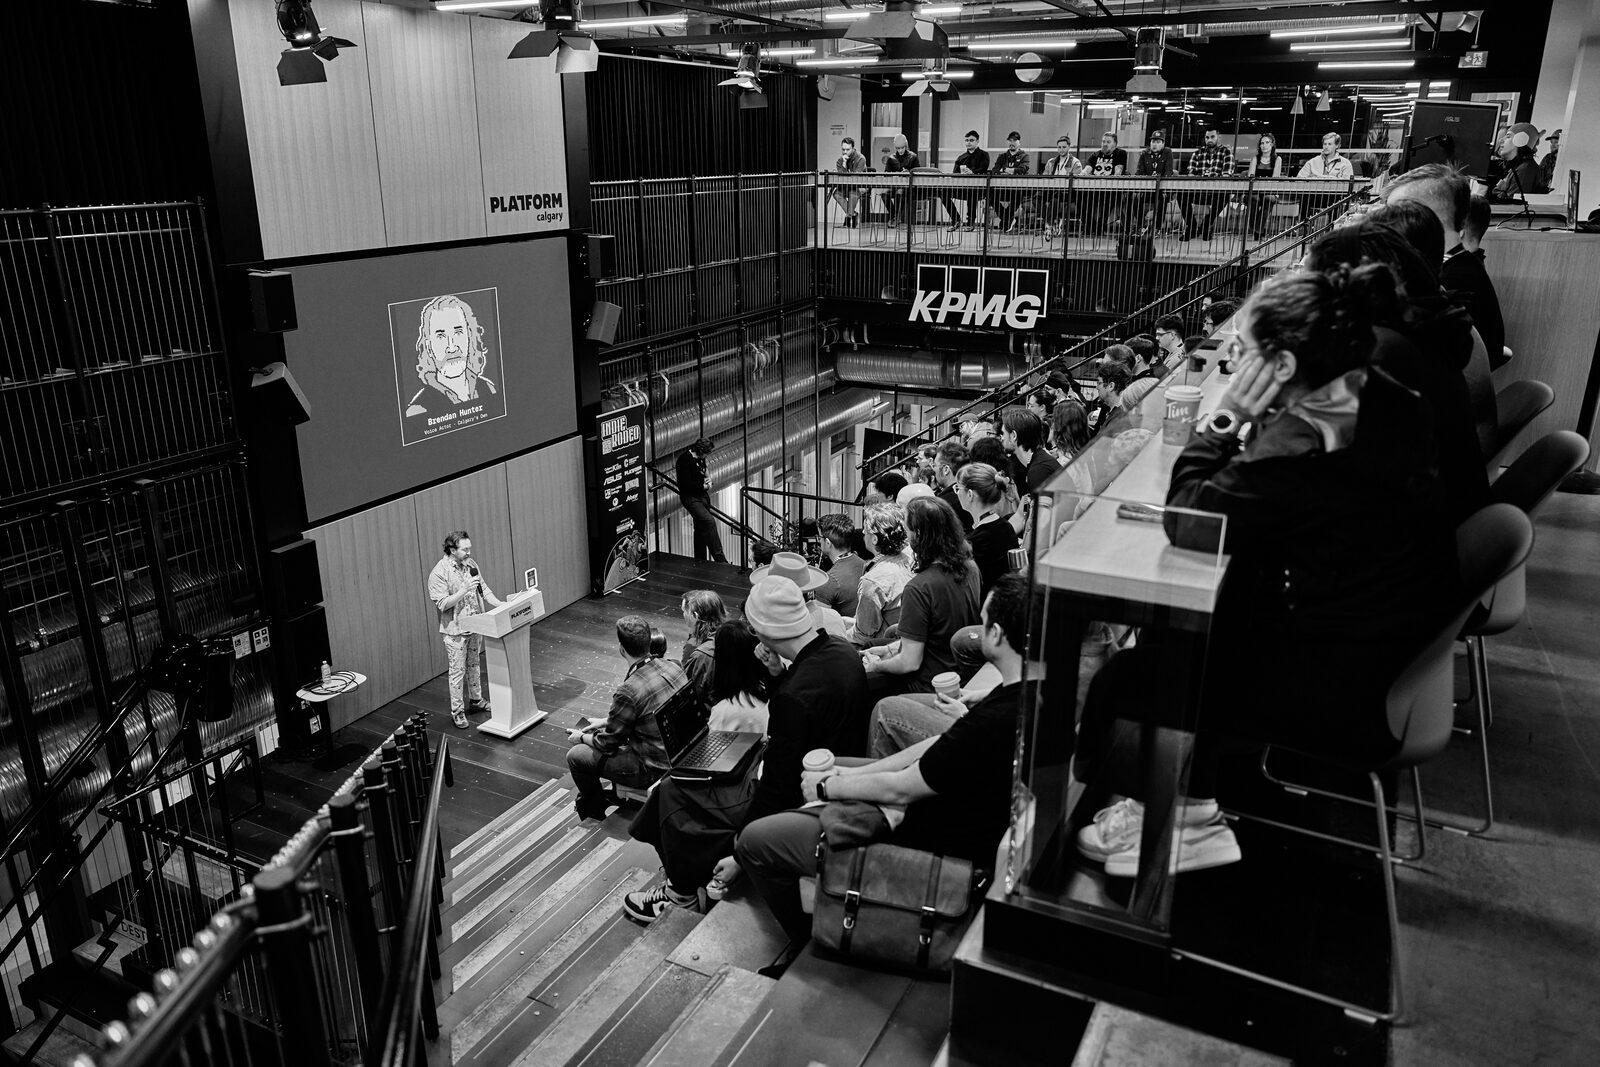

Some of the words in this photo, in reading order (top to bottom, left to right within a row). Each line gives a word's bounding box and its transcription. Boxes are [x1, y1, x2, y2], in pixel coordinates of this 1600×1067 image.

[489, 192, 563, 213] PLATFORM
[536, 211, 563, 223] calgary
[908, 289, 1042, 329] KPMG
[423, 427, 438, 435] Voice
[438, 423, 452, 431] Actor
[457, 415, 479, 426] Calgary's
[427, 412, 457, 426] Brendan
[459, 404, 483, 417] Hunter
[602, 417, 626, 437] INDIE
[611, 426, 639, 448] RODEO
